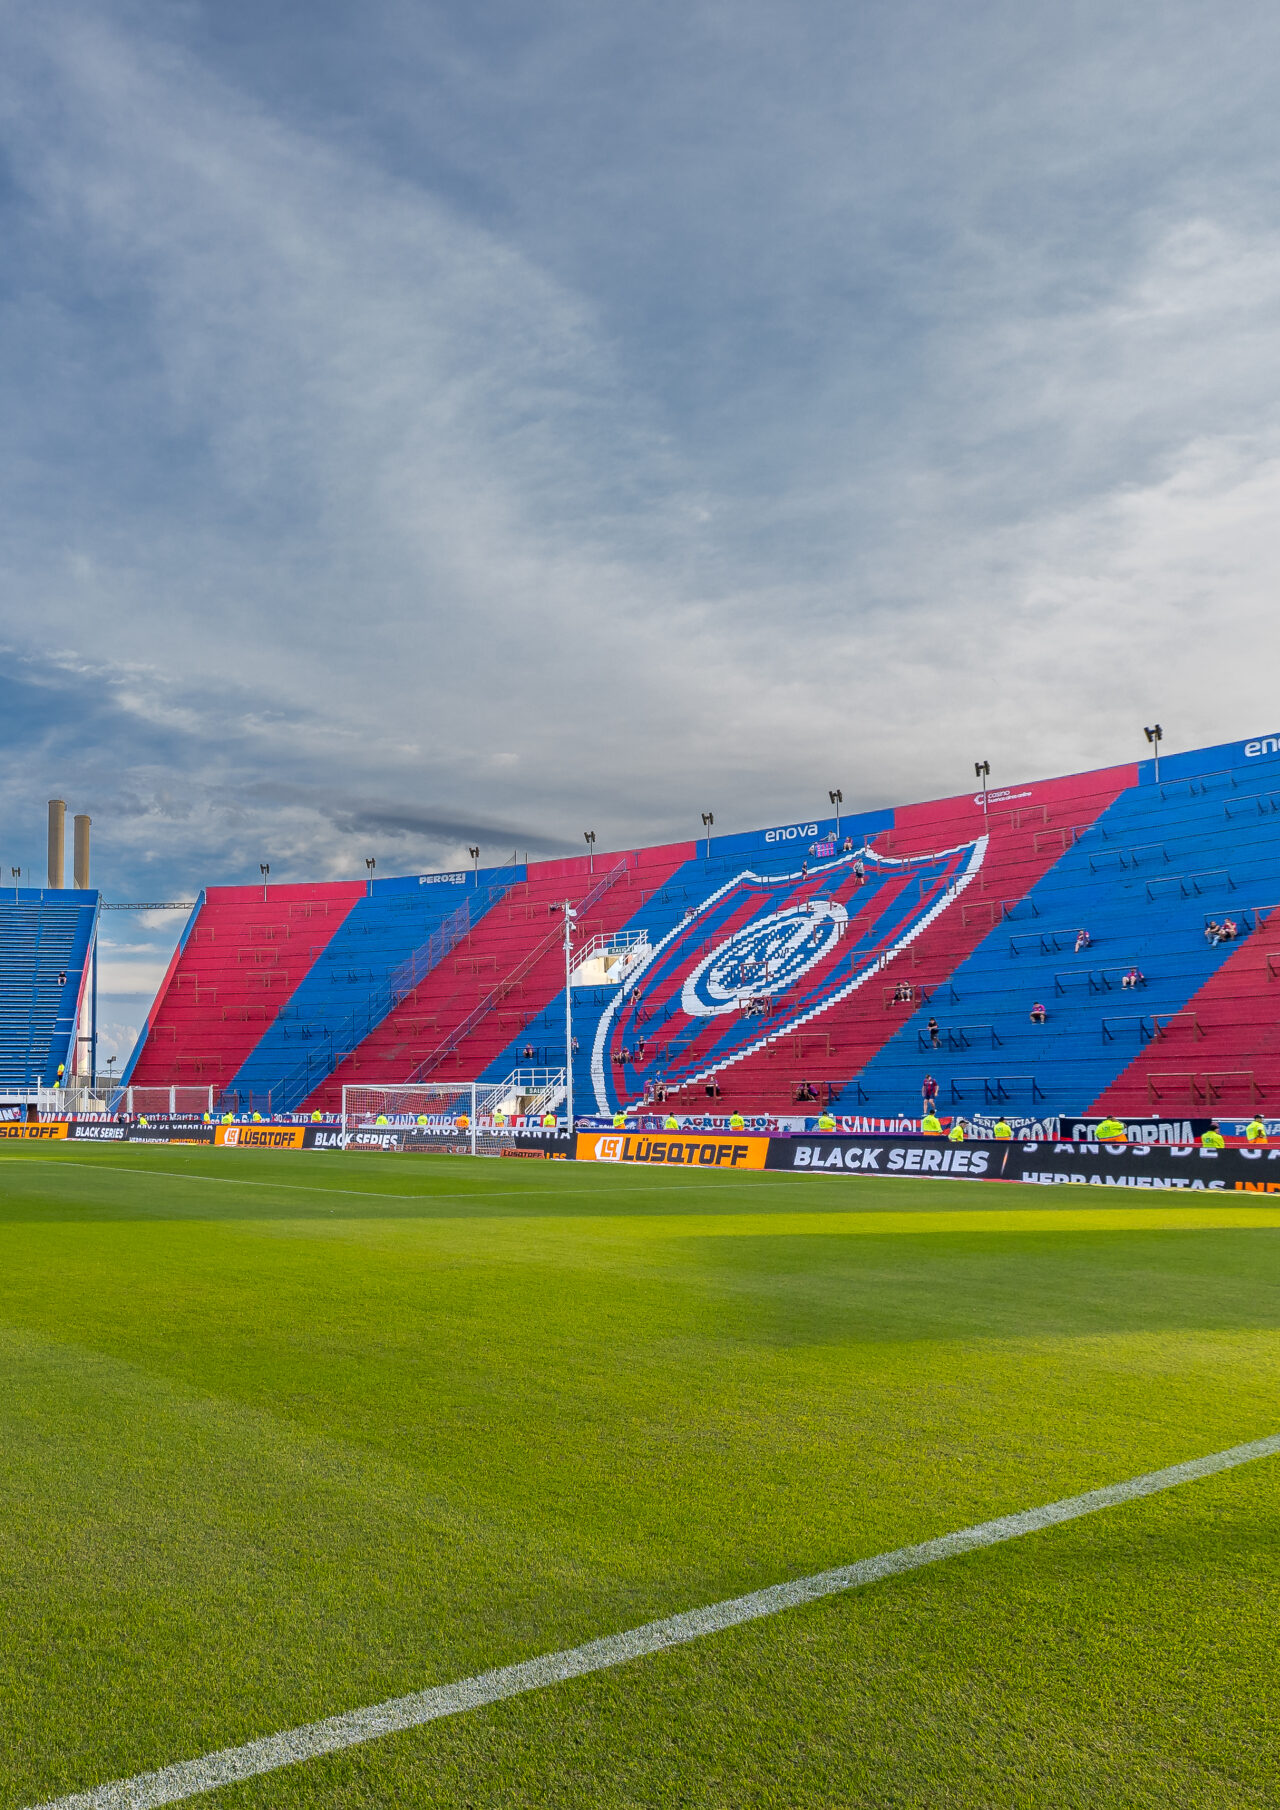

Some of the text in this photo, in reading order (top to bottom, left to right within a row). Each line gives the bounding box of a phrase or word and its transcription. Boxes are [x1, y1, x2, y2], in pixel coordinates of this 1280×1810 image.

[1244, 738, 1280, 757] en
[765, 824, 818, 843] enova
[419, 873, 466, 884] PEROZZI
[1006, 1117, 1037, 1129] FICIAL
[75, 1126, 124, 1139] BLACK SERIES
[239, 1129, 296, 1146] LÜSQTOFF
[622, 1138, 748, 1166] LÜSQTOFF
[794, 1146, 990, 1174] BLACK SERIES
